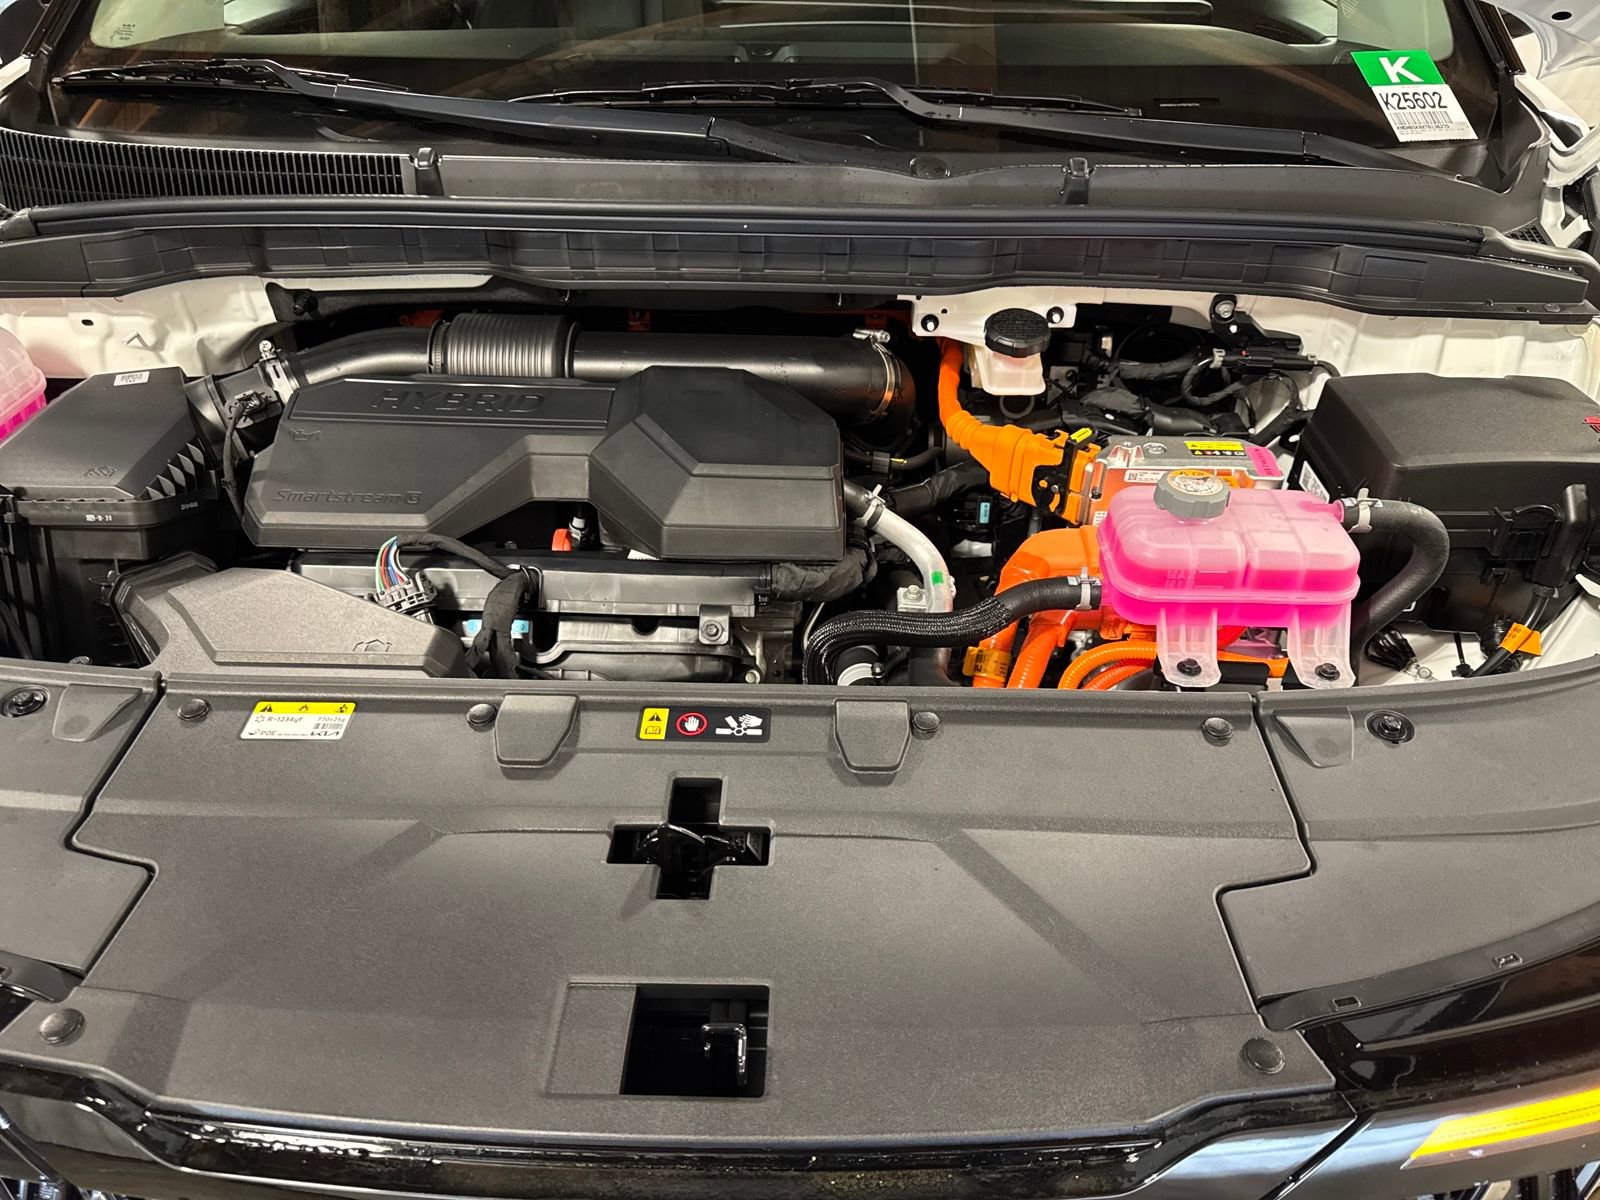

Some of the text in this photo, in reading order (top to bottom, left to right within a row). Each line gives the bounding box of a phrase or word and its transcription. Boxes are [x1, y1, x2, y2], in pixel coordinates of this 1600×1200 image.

[1379, 56, 1424, 83] K
[1379, 91, 1448, 111] K25602
[371, 388, 545, 413] HYBRID
[273, 488, 402, 502] Smartstream
[267, 716, 303, 724] R-1234yf
